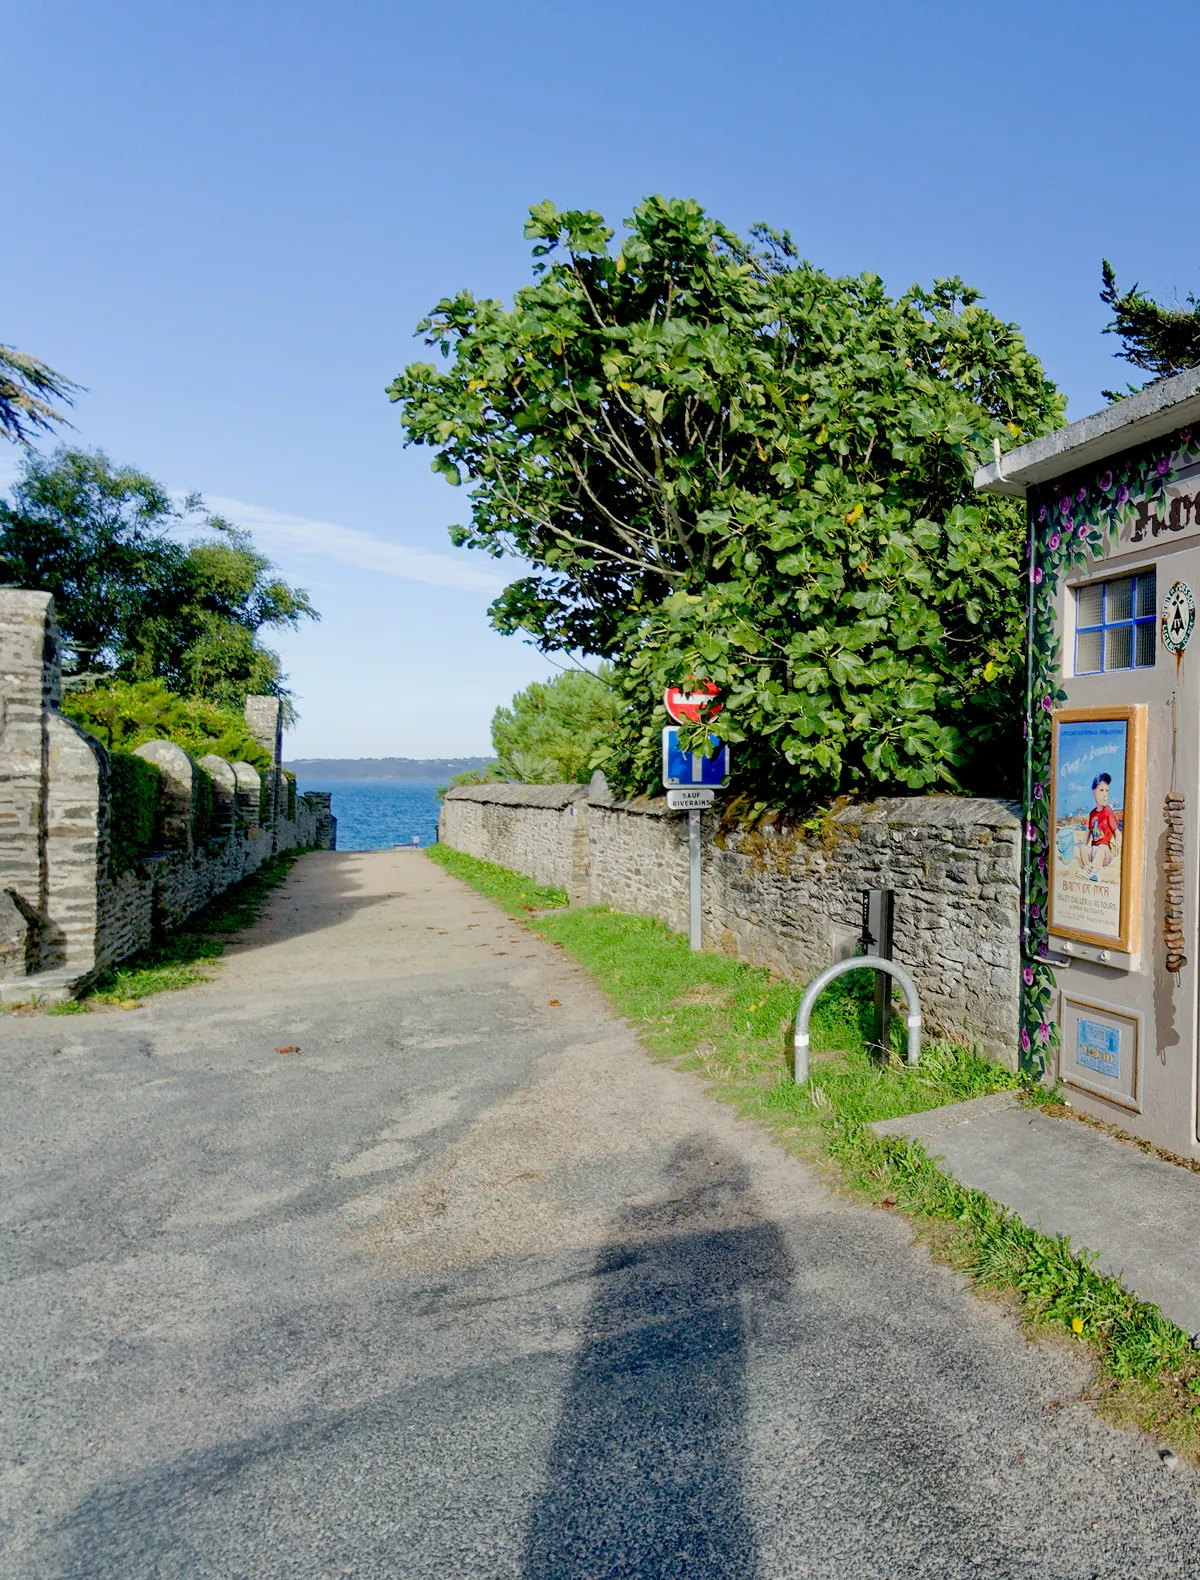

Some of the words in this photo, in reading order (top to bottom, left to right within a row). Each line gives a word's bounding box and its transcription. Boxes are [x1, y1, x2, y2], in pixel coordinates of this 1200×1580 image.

[1082, 883, 1091, 895] DE
[1093, 885, 1110, 898] MER
[1094, 900, 1117, 911] RETOURS
